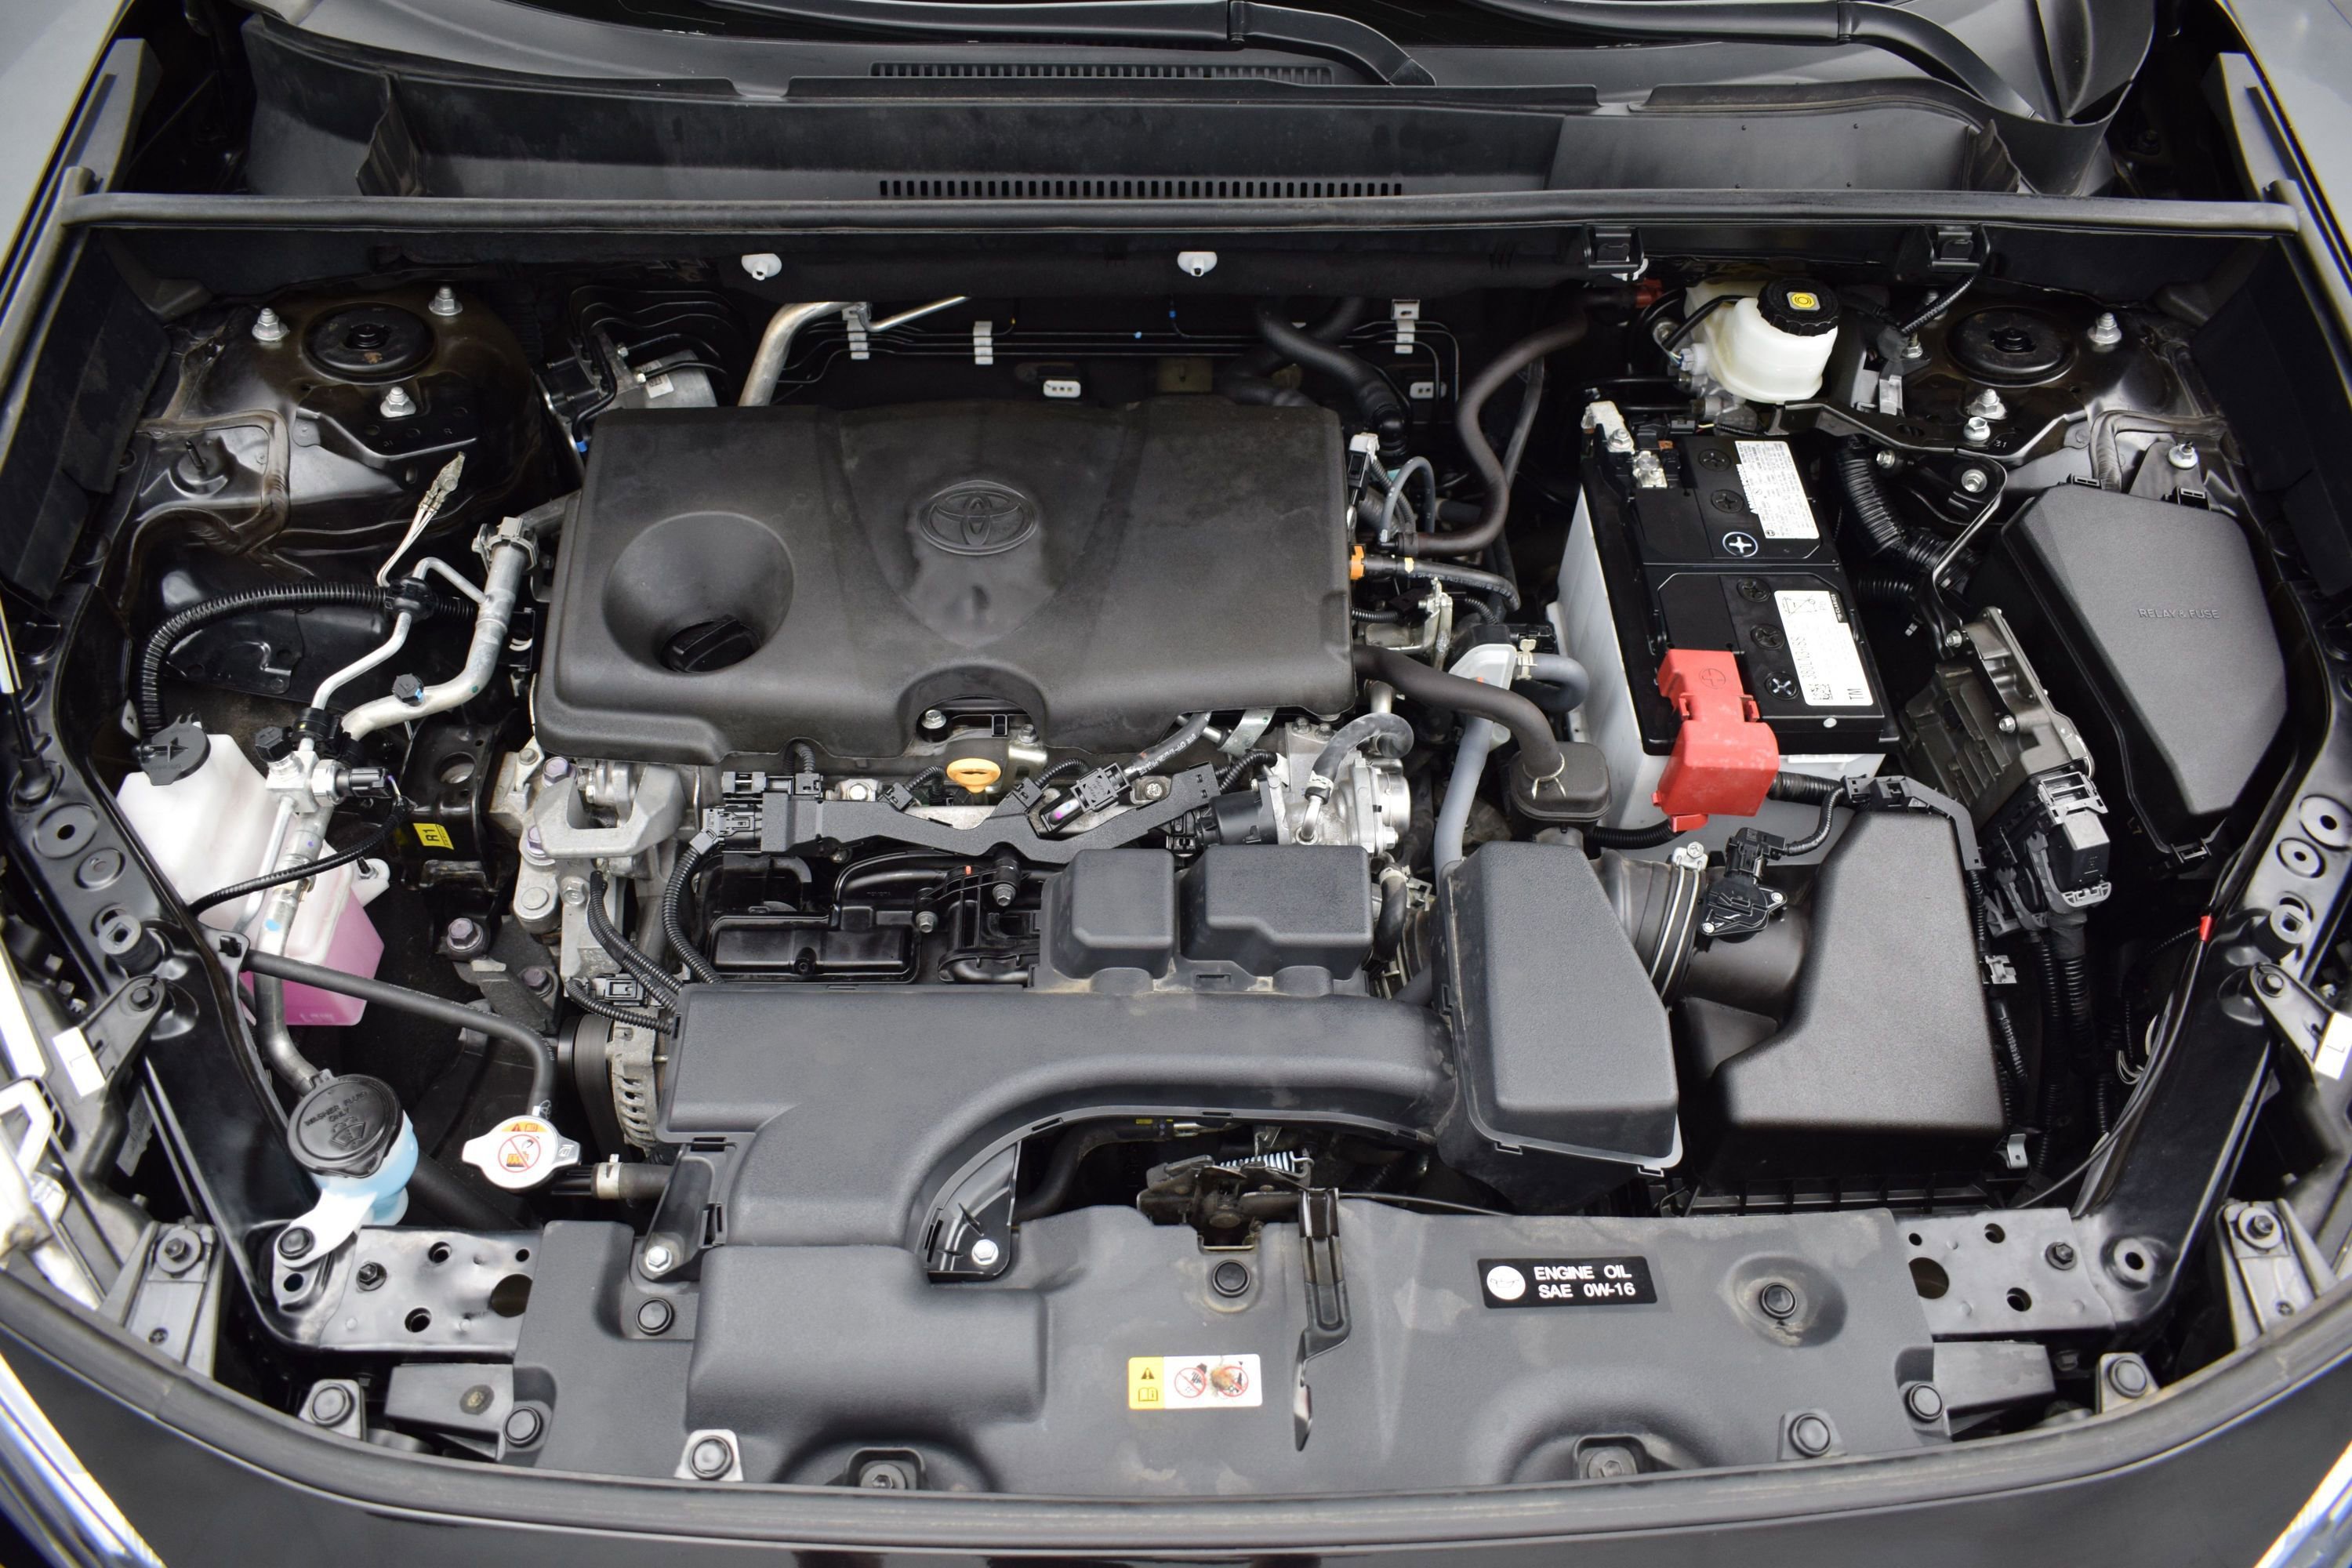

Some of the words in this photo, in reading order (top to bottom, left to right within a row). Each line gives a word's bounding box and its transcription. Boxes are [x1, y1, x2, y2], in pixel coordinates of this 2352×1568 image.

[1831, 593, 1841, 617] CLARIOS
[2138, 608, 2176, 618] RELAY
[2189, 609, 2220, 619] FUSE
[1847, 688, 1864, 700] TM
[423, 829, 439, 841] R1
[303, 1105, 340, 1127] WASHER
[1534, 1265, 1595, 1281] ENGINE
[1603, 1265, 1632, 1279] OIL
[1538, 1283, 1573, 1298] SAE
[1583, 1282, 1636, 1298] 0W-16
